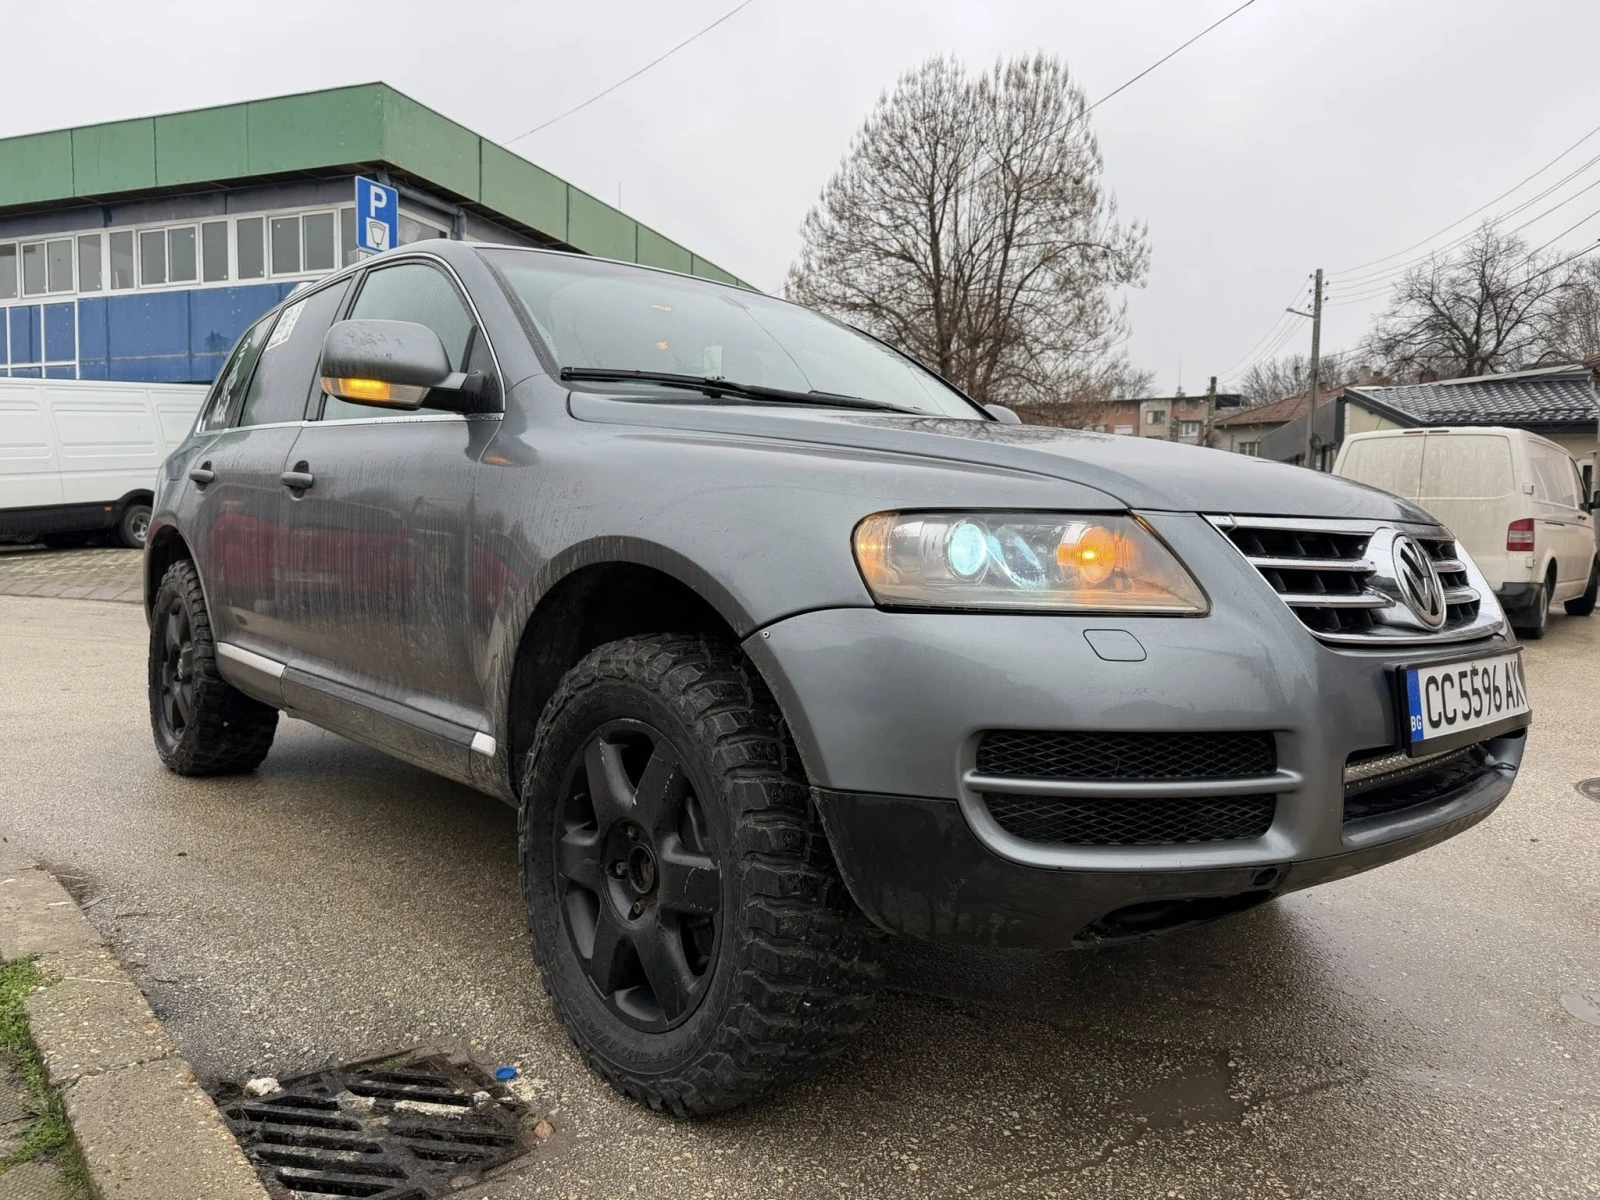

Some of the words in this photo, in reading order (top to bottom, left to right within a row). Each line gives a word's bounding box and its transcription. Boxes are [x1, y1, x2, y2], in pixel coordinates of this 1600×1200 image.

[370, 184, 387, 218] P
[1425, 673, 1457, 729] CC
[1458, 665, 1502, 721] 5596
[1410, 716, 1423, 732] BG
